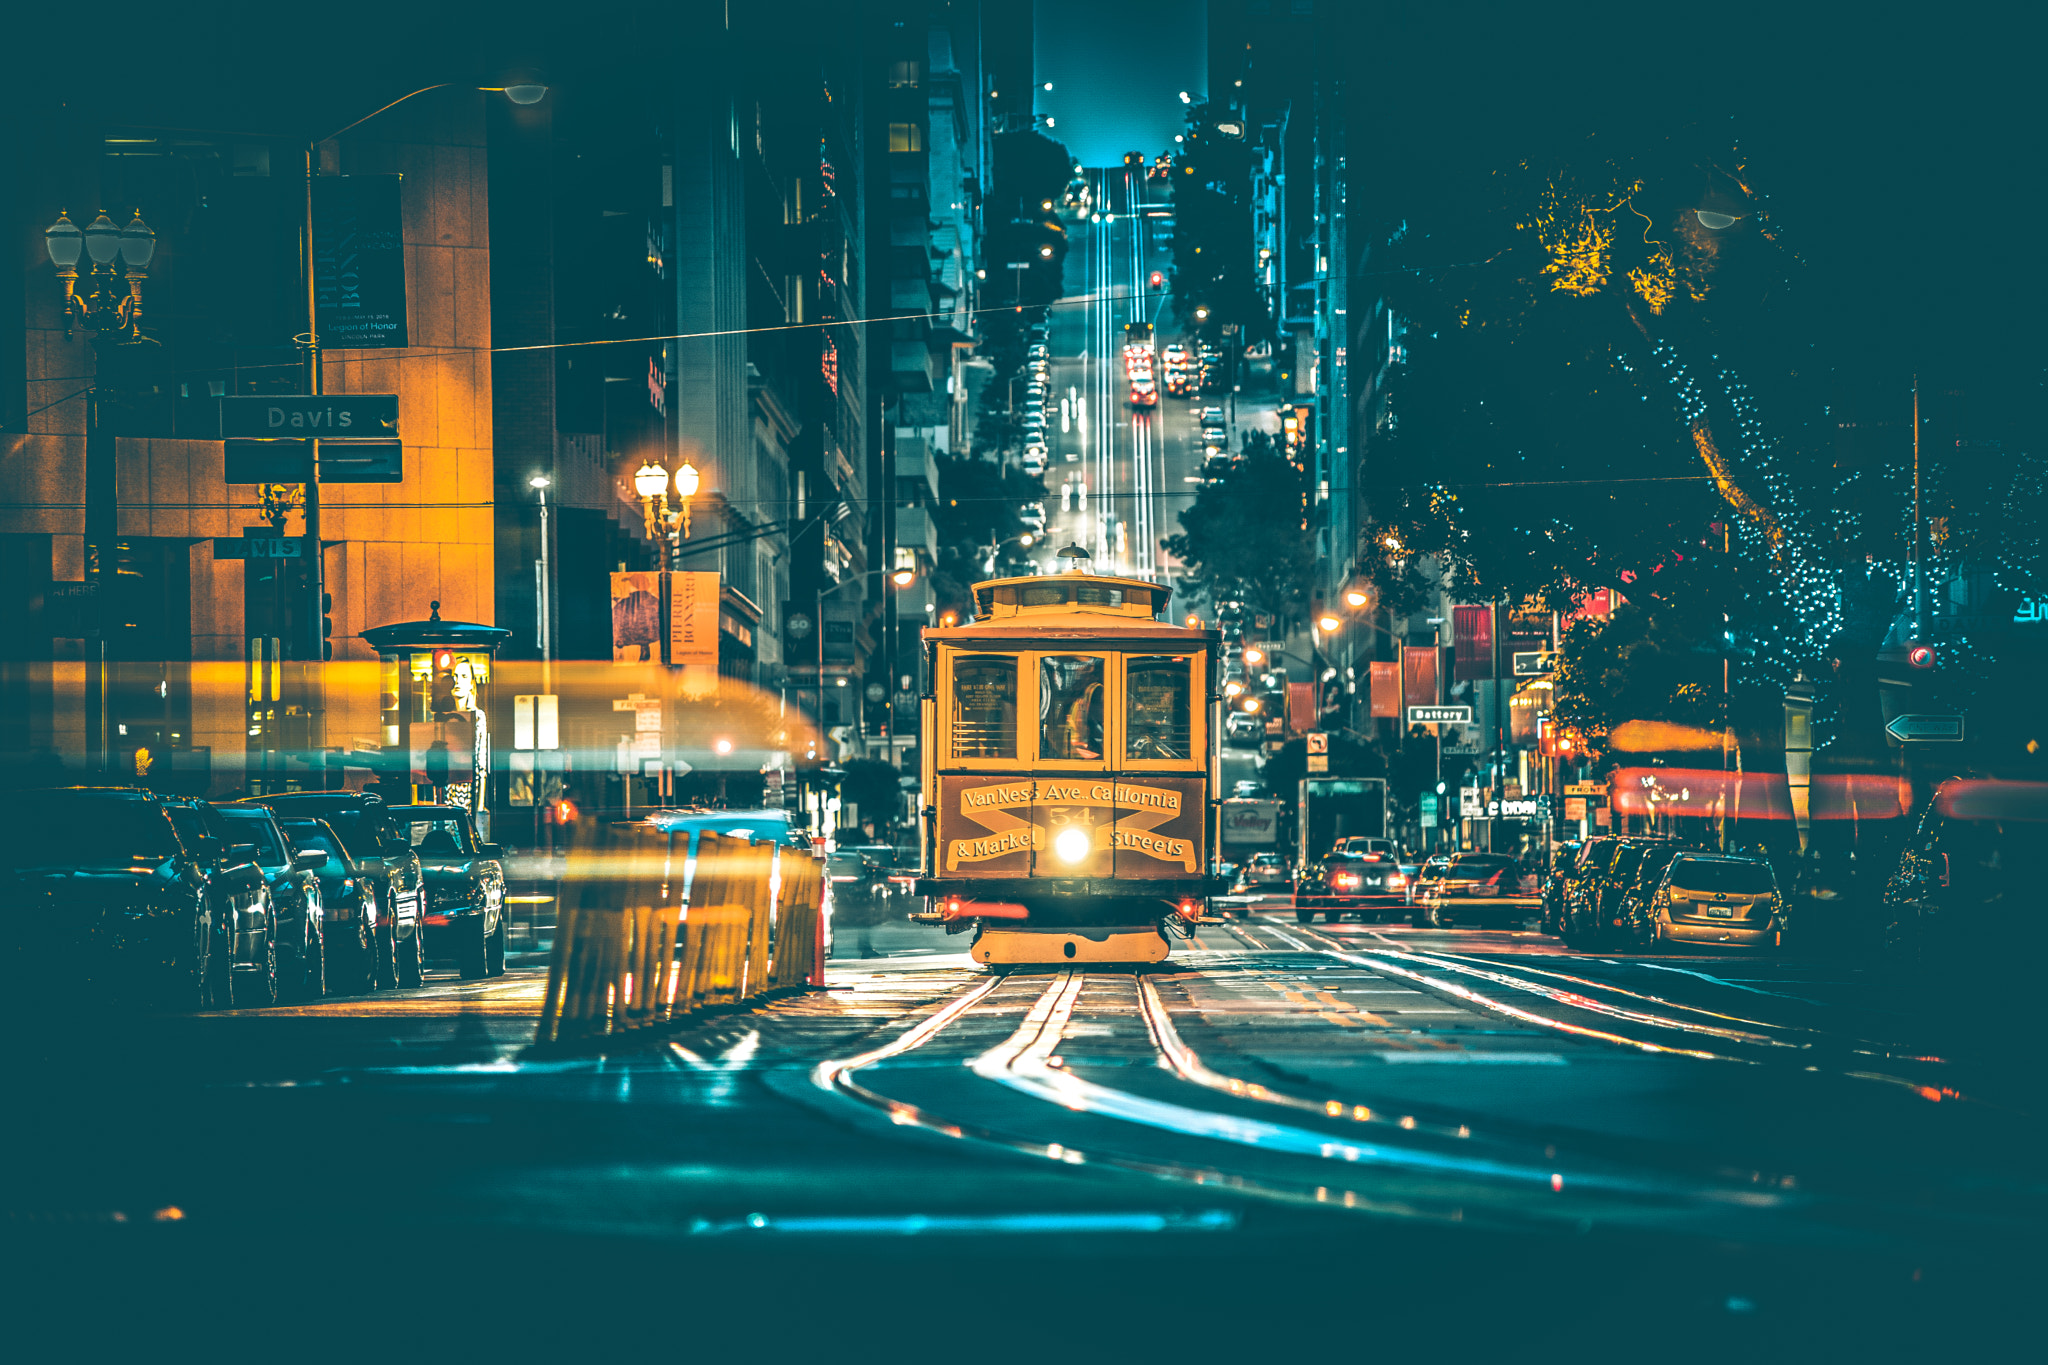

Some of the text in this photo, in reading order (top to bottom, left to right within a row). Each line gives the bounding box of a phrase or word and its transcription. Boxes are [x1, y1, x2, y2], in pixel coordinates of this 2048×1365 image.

[328, 322, 398, 333] Legion of Honor
[267, 407, 353, 428] Davis
[223, 540, 295, 556] DAVIS
[672, 592, 683, 643] PIERRE
[790, 619, 809, 630] 50
[1416, 710, 1462, 721] Battery
[964, 793, 995, 808] Van
[997, 787, 1040, 803] Ness
[1090, 786, 1178, 810] California
[1050, 807, 1095, 826] 54
[957, 842, 970, 857] &
[1109, 830, 1184, 857] Streets
